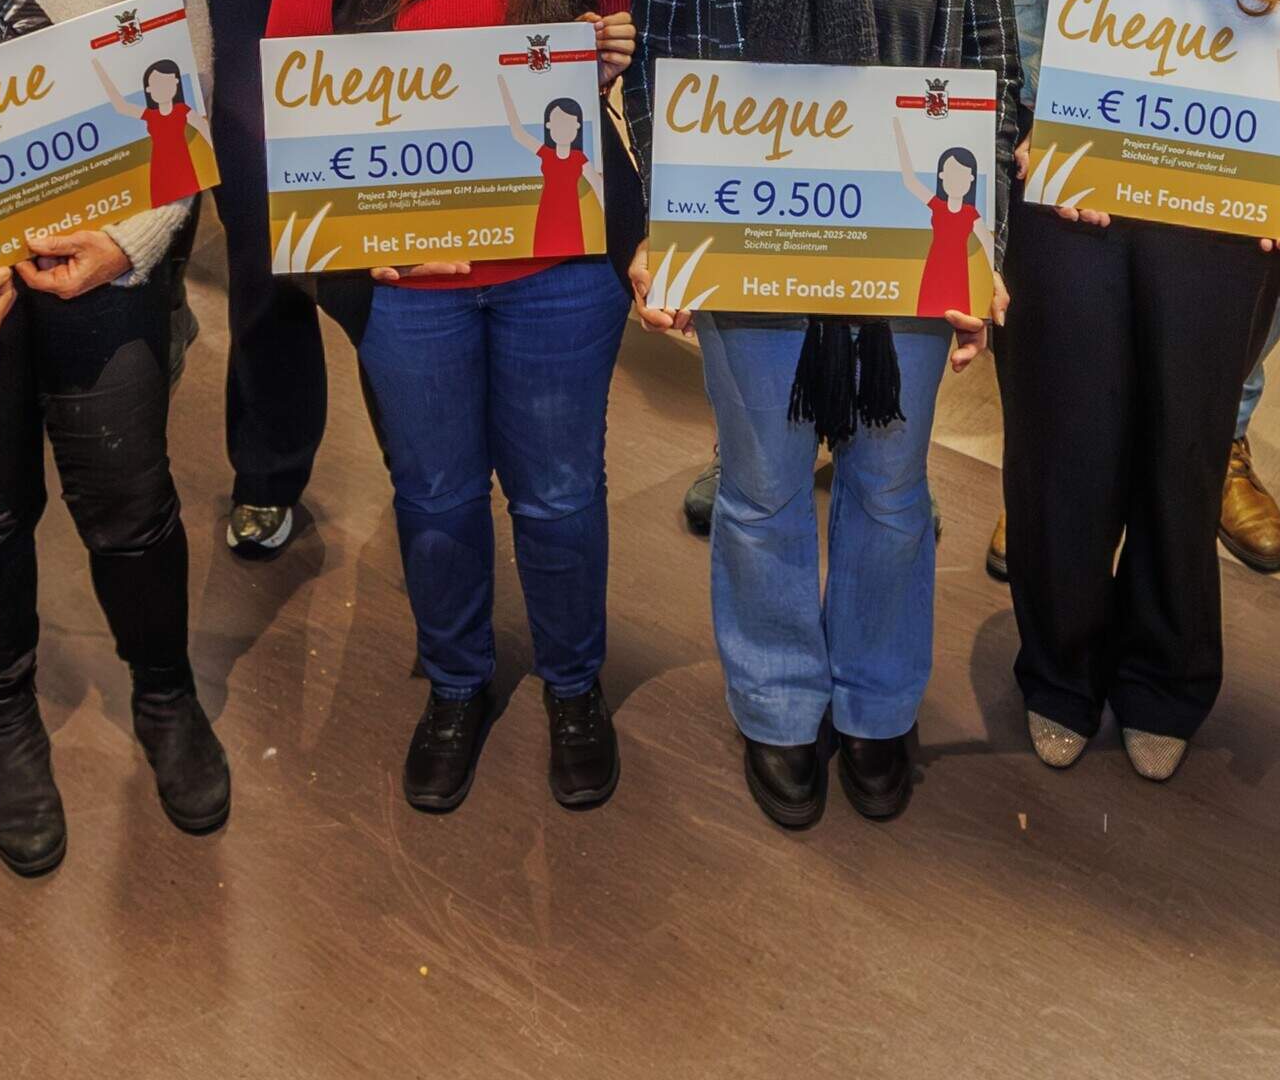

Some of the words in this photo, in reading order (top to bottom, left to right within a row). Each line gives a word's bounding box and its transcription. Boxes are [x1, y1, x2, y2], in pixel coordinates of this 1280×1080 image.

[272, 48, 457, 128] Cheque
[664, 72, 852, 162] Cheque
[1051, 100, 1091, 119] t.w.v.
[1097, 90, 1124, 123] €
[1135, 94, 1256, 143] 15.000
[283, 170, 325, 183] t.w.v.
[329, 147, 355, 180] €
[368, 140, 473, 178] 5.000
[24, 213, 82, 242] Fonds
[86, 190, 132, 222] 2025
[667, 199, 709, 214] t.w.v.
[714, 179, 741, 215] €
[753, 180, 861, 218] 9.500
[1116, 183, 1152, 205] Het
[1157, 189, 1214, 214] Fonds
[1219, 199, 1267, 222] 2025
[363, 235, 399, 253] Het
[404, 230, 462, 250] Fonds
[467, 226, 514, 246] 2025
[743, 226, 773, 238] Project
[774, 227, 822, 239] Tuinfestival,
[822, 229, 868, 240] 2025-2026
[743, 238, 782, 251] Stichting
[782, 239, 828, 251] Biosintrum
[743, 276, 779, 296] Het
[786, 277, 845, 298] Fonds
[850, 280, 899, 299] 2025
